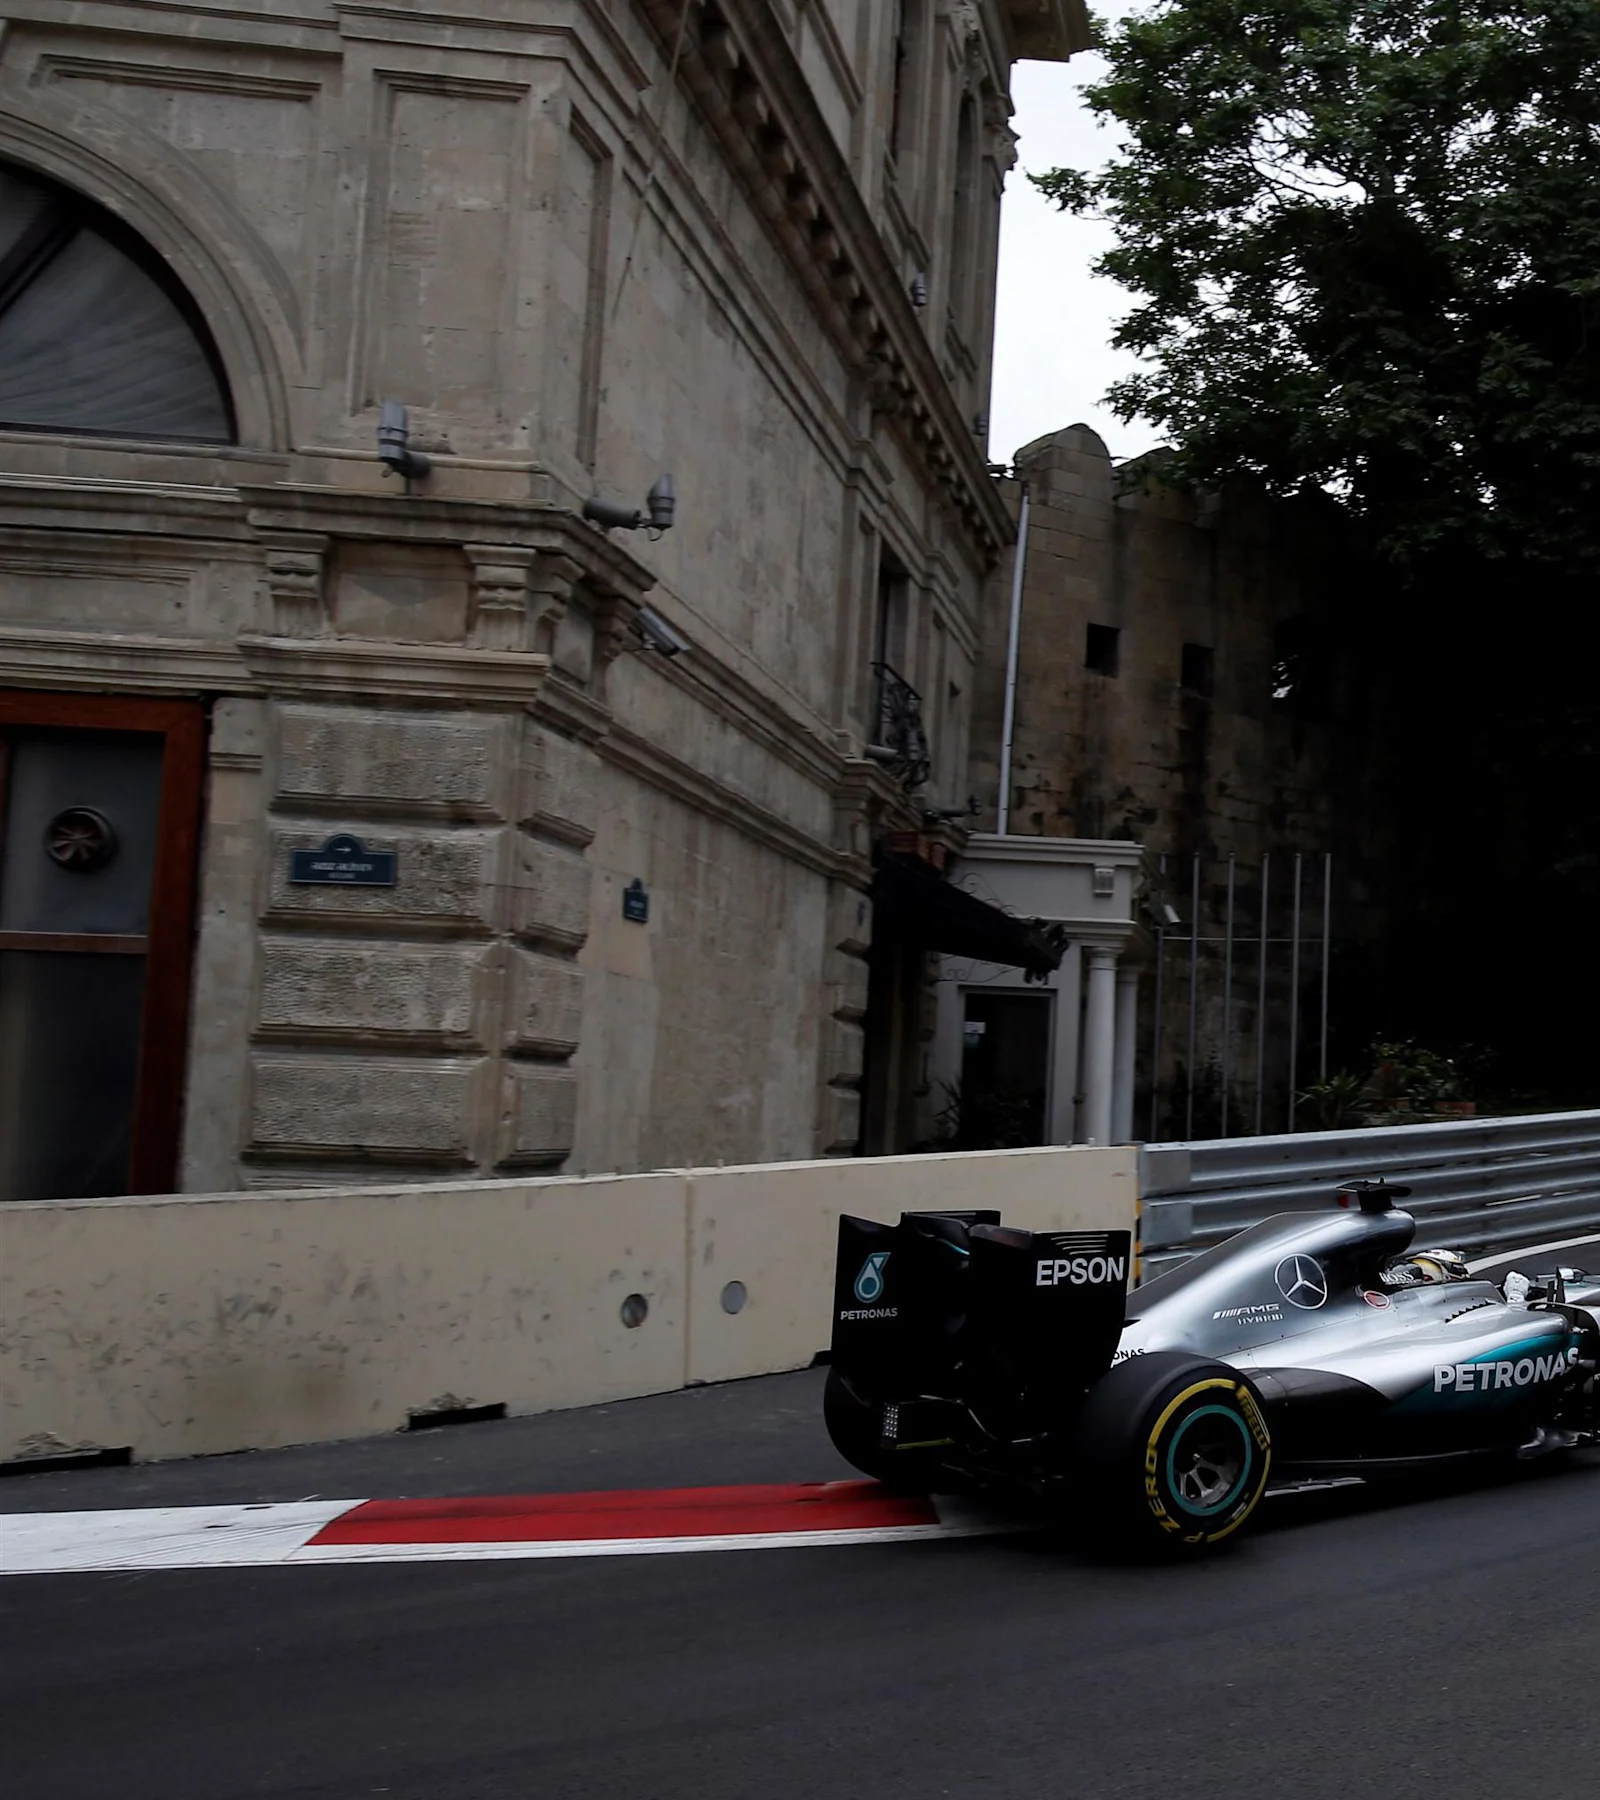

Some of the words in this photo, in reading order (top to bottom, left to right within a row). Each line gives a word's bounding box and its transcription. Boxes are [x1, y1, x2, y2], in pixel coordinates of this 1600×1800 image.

[1035, 1255, 1125, 1287] EPSON
[840, 1307, 899, 1321] PETRONAS
[1237, 1303, 1280, 1316] AMG
[1238, 1313, 1284, 1326] HYBRID
[1112, 1348, 1146, 1361] ONAS
[1433, 1346, 1580, 1394] PETRONAS
